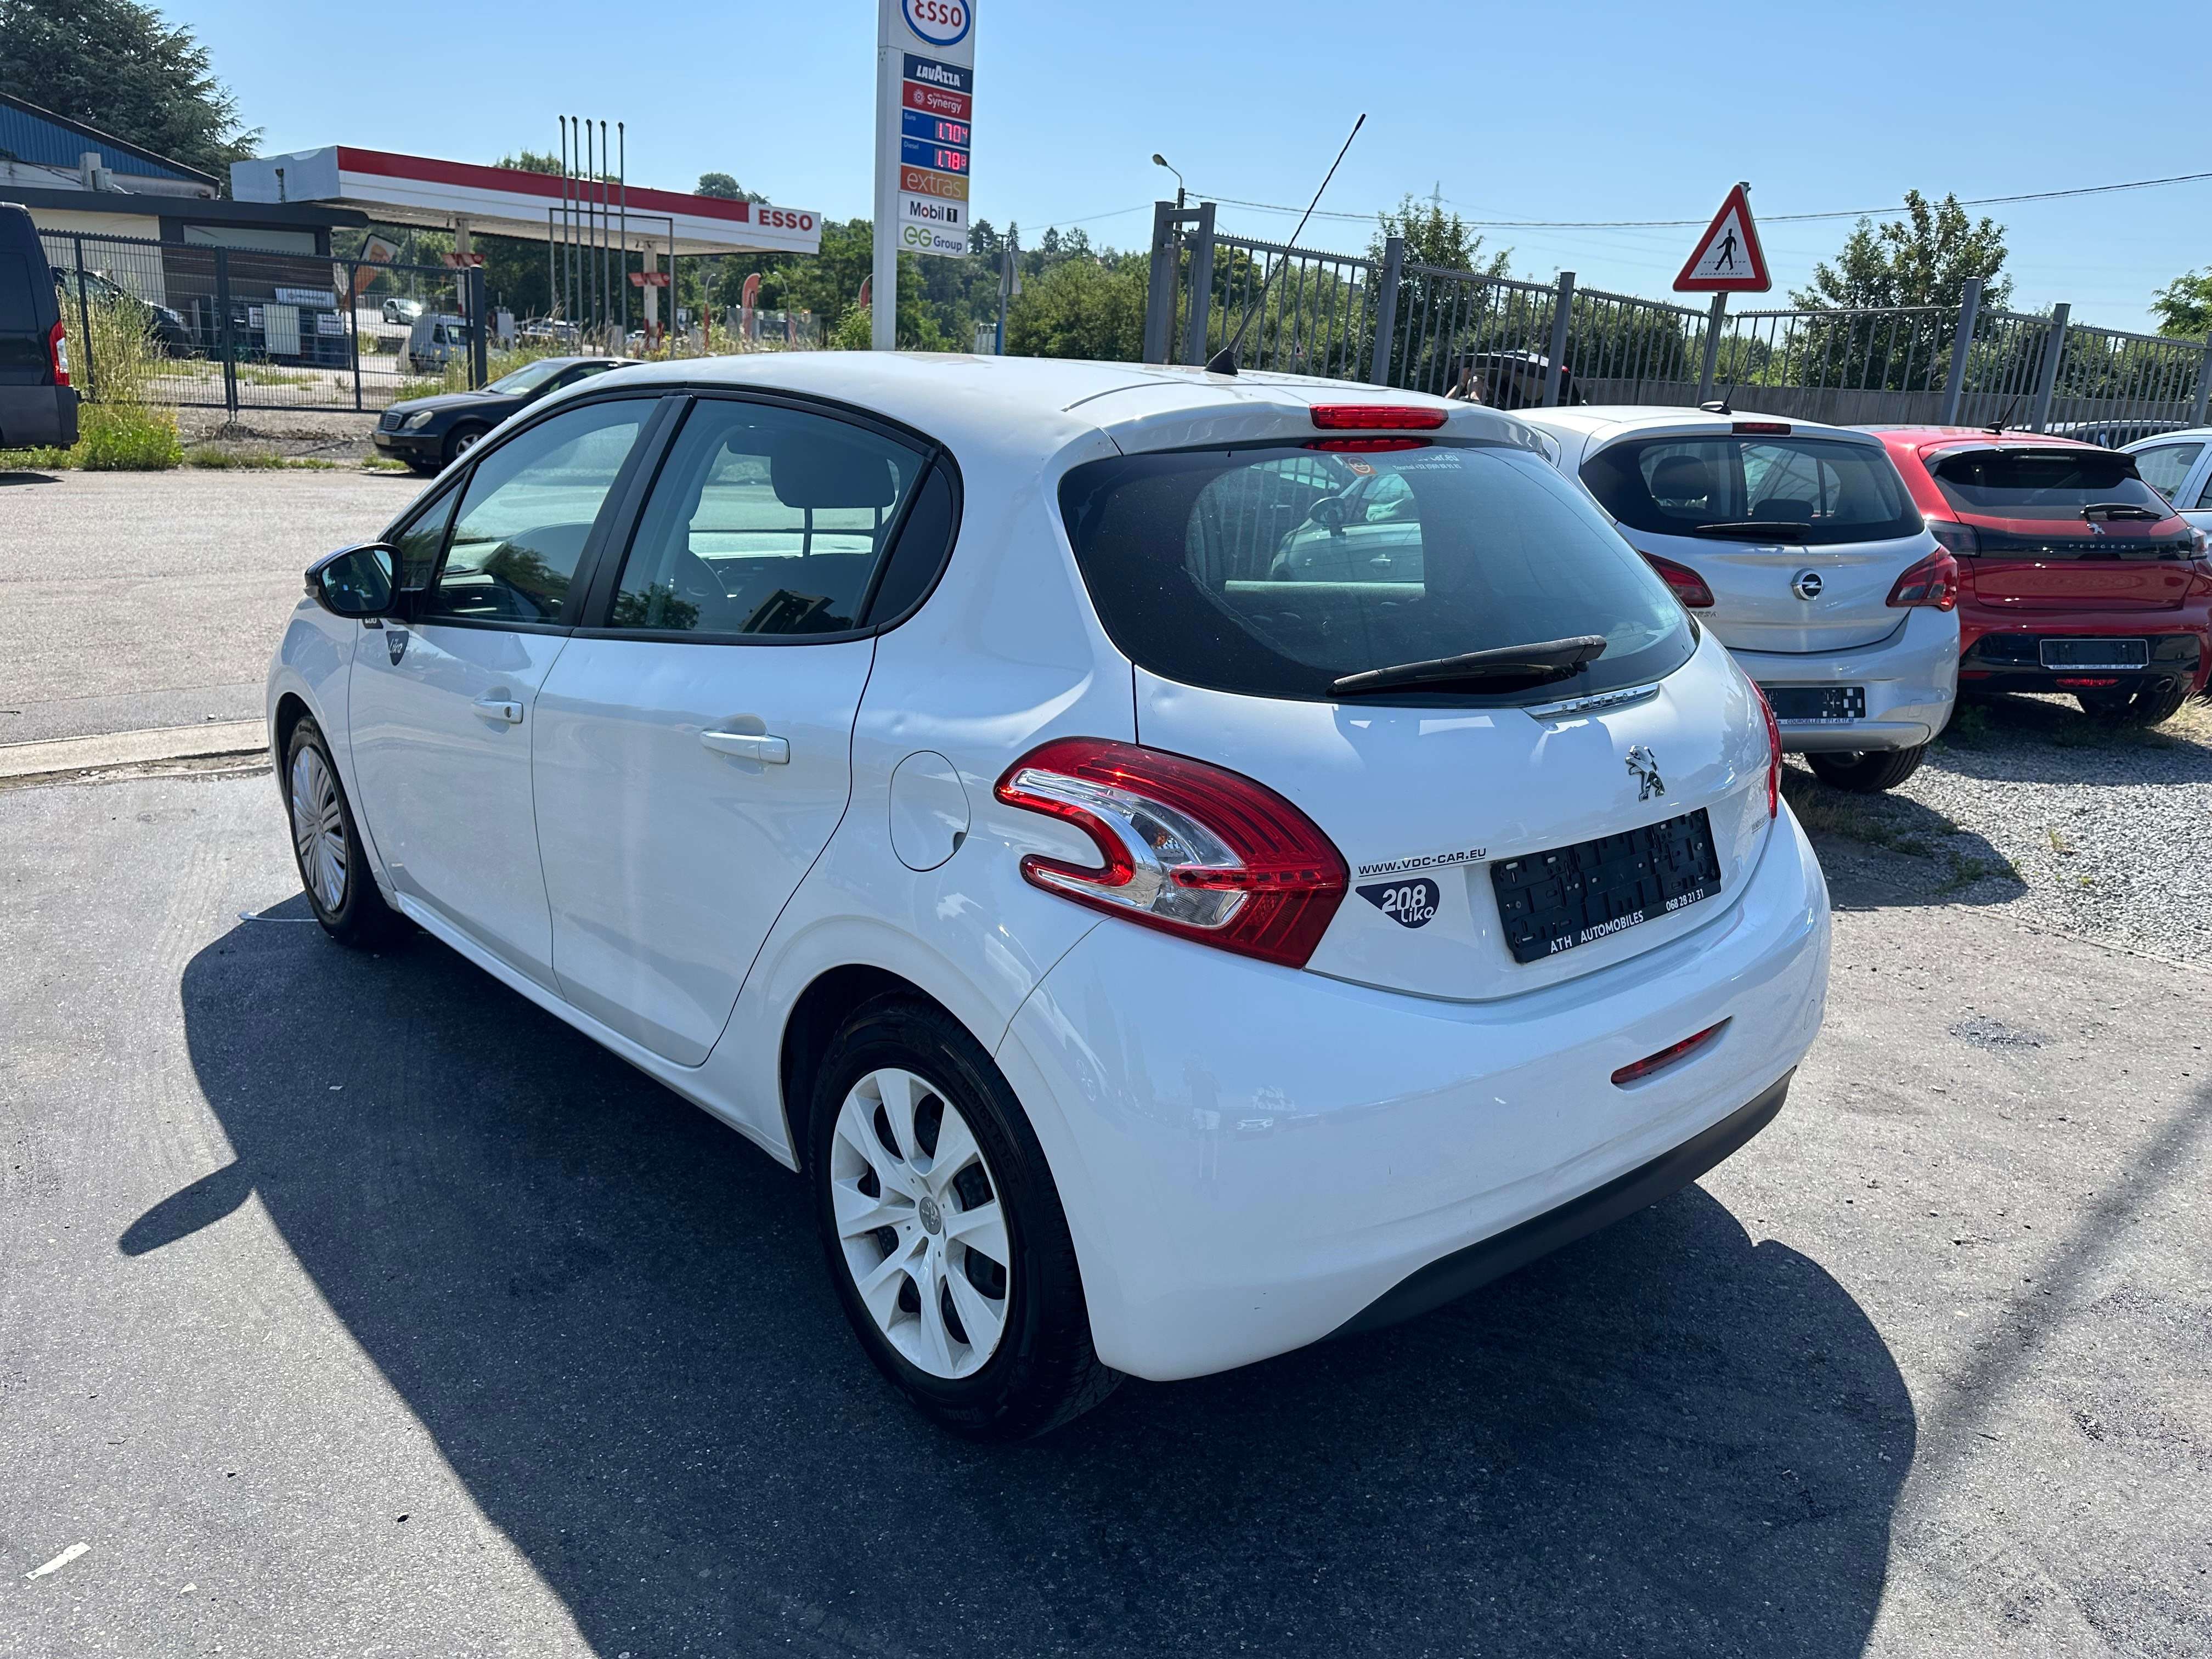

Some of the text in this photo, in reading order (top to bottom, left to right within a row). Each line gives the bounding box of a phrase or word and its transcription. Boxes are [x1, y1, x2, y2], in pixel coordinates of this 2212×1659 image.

[916, 65, 961, 87] LAVAZZA
[927, 93, 961, 114] Synergy
[904, 140, 919, 150] Diesel
[907, 172, 961, 198] extras
[759, 209, 813, 231] ESSO
[910, 201, 944, 221] Mobil
[934, 235, 962, 252] Group
[1562, 690, 1637, 712] PEUGEOT
[1358, 848, 1486, 875] WWW.VDC-CAR.EU
[1382, 884, 1426, 912] 208
[1550, 888, 1704, 953] ATH AUTOMOBILES 068 28 21 31
